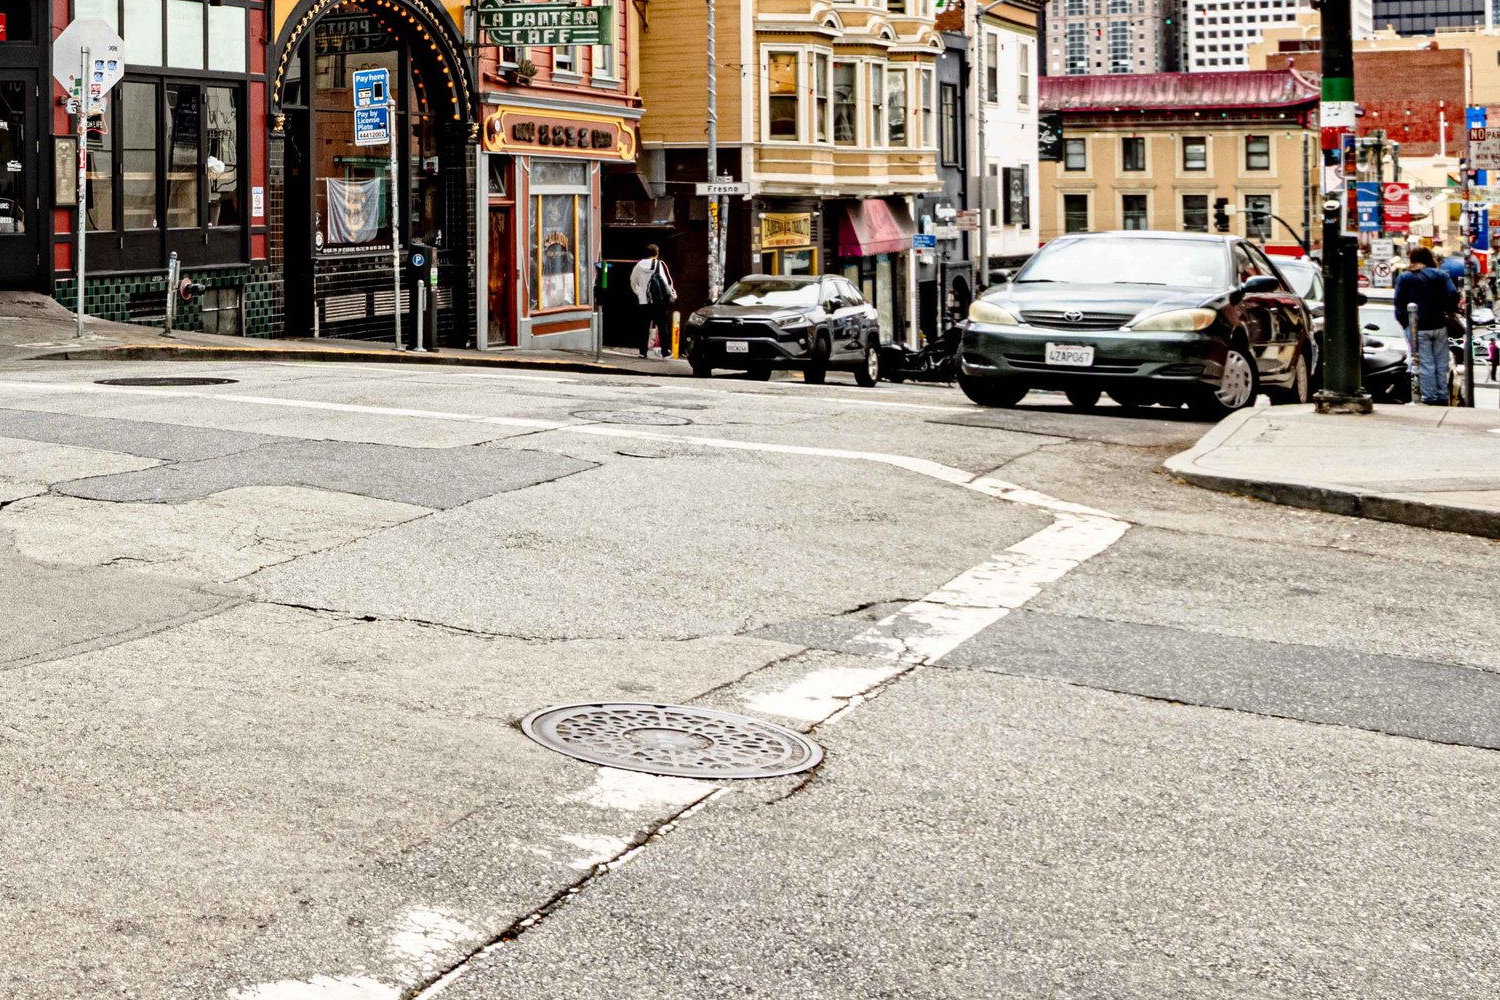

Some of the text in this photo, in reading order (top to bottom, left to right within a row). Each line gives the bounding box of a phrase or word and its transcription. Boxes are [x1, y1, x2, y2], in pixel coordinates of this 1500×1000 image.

[480, 10, 598, 27] LA PANTERA
[511, 29, 571, 44] CAFE
[355, 73, 385, 84] Pay here
[369, 110, 378, 118] by
[1471, 129, 1485, 140] NO
[707, 185, 739, 193] Fresno
